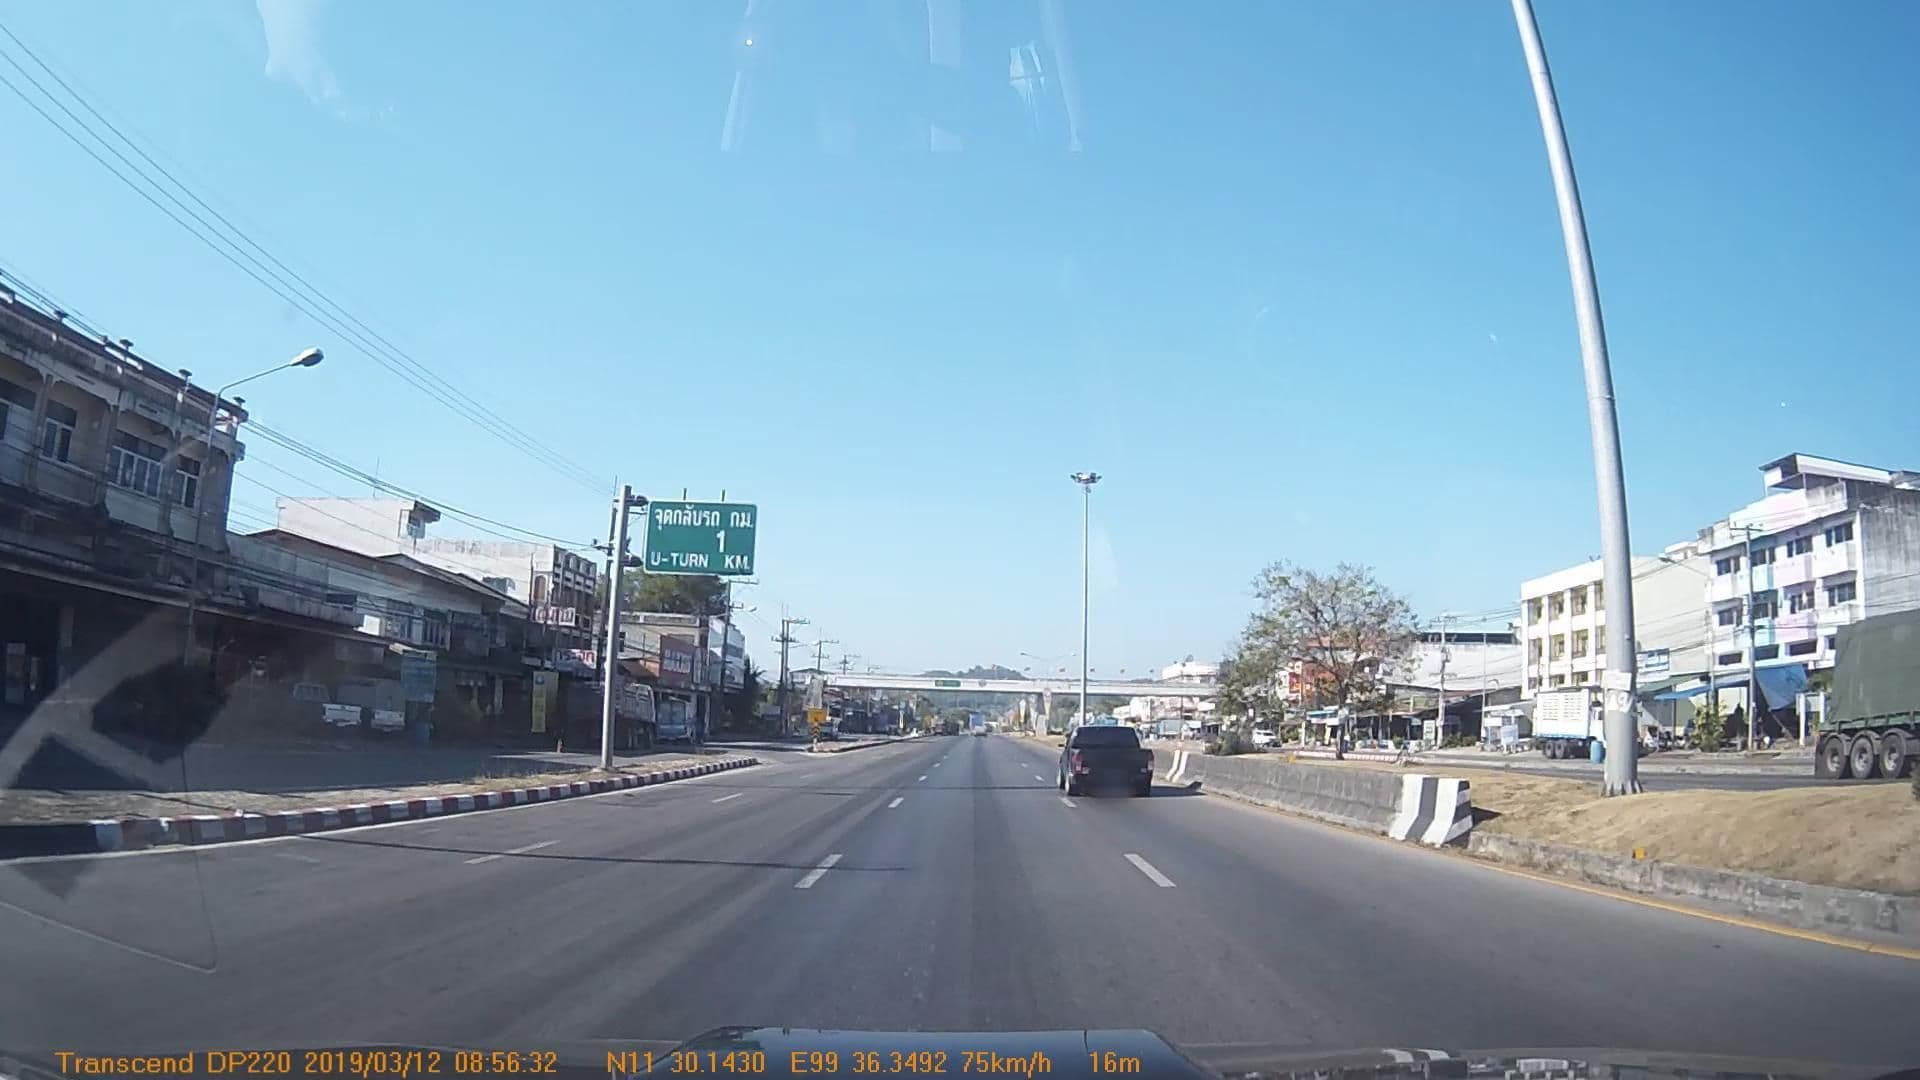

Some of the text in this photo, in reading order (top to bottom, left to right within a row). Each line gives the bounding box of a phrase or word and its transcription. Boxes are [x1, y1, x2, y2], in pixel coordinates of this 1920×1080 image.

[655, 504, 720, 531] จุดกลับรถ
[716, 530, 726, 553] 1
[651, 551, 708, 568] U-TURN
